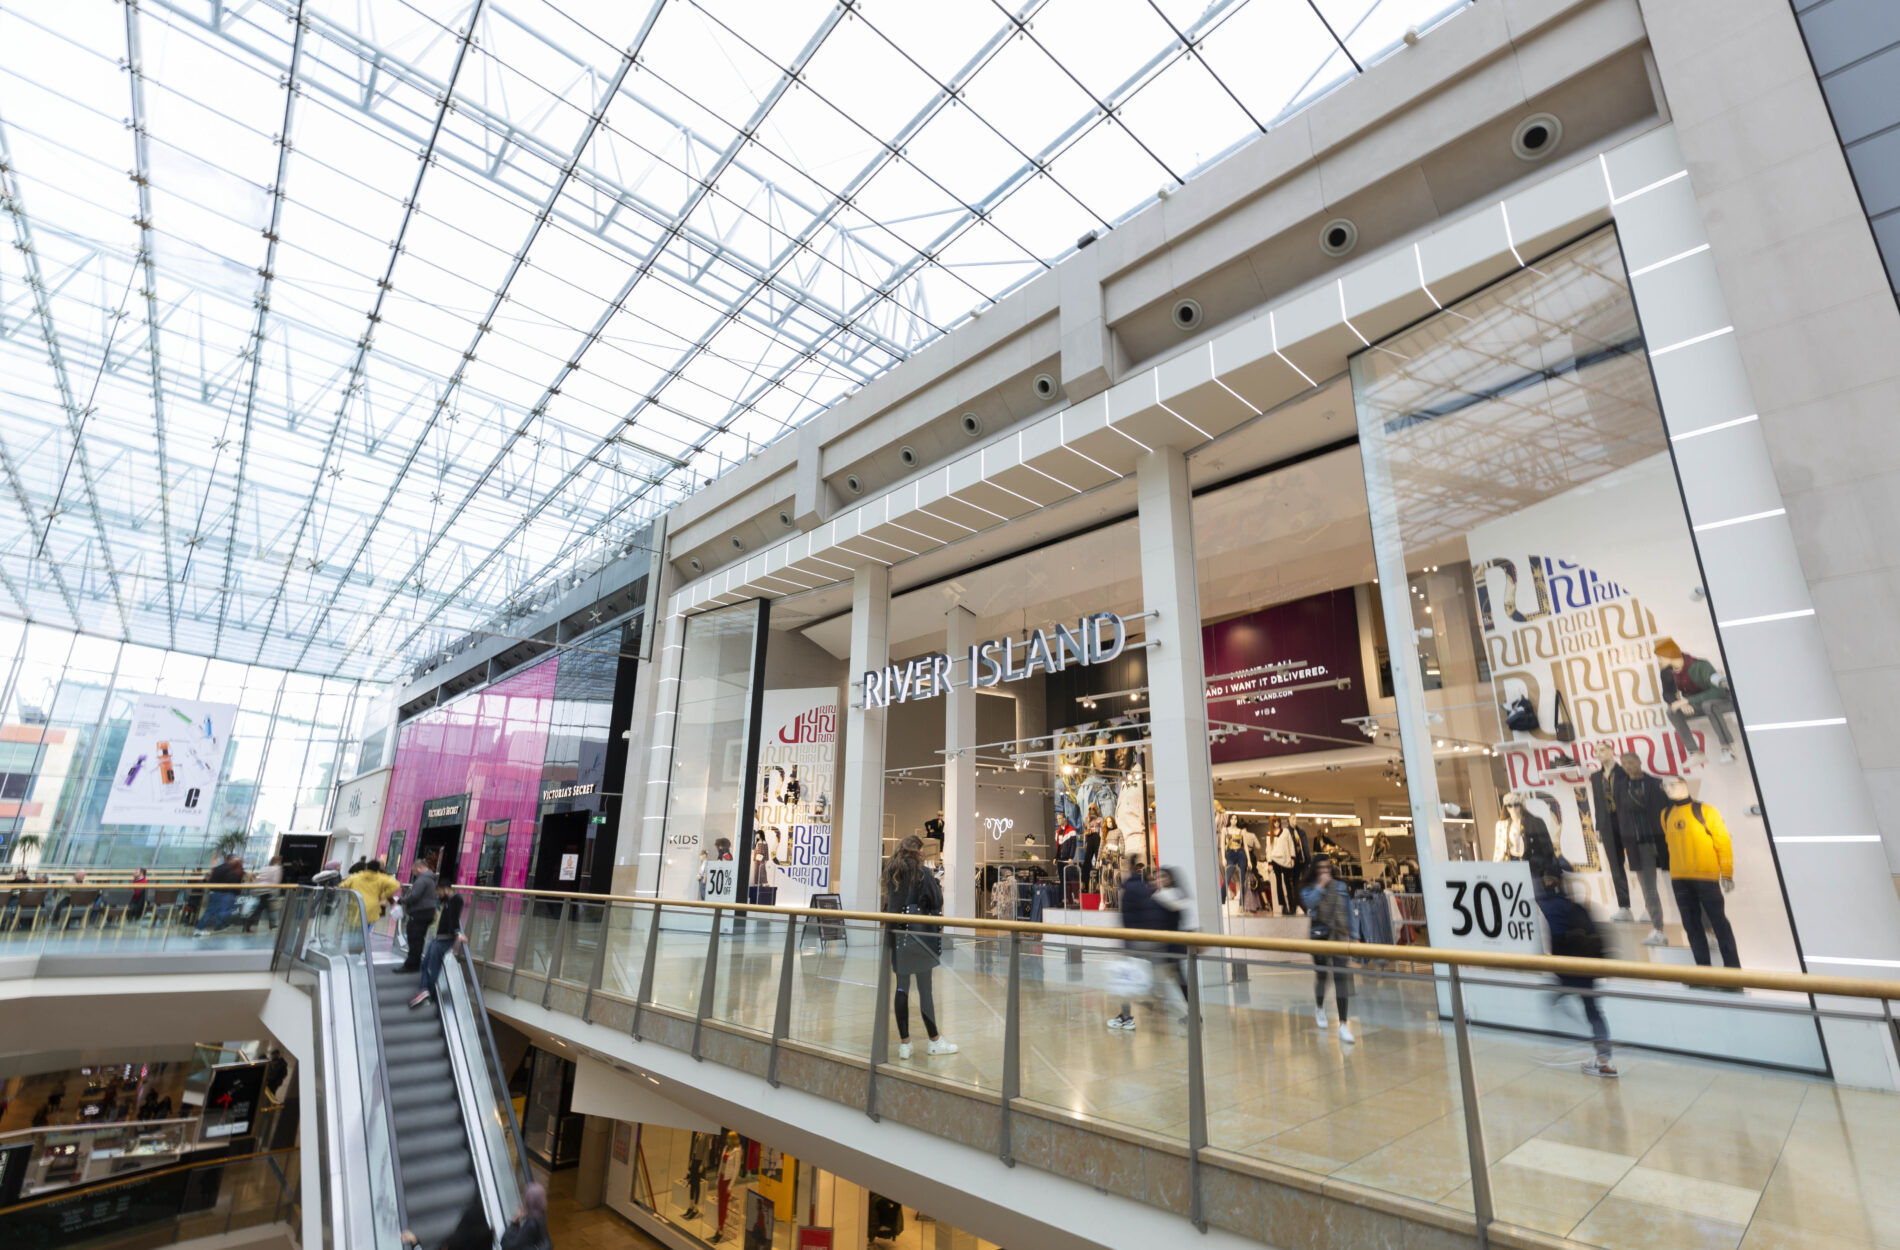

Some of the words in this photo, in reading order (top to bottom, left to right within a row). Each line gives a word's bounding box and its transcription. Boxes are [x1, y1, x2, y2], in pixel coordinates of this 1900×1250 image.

[863, 654, 953, 710] RIVER
[968, 611, 1126, 689] ISLAND
[1206, 687, 1223, 697] AND
[1230, 679, 1257, 693] WANT
[1259, 677, 1269, 687] IT
[1271, 665, 1329, 685] DELIVERED.
[543, 786, 572, 800] VICTORIA'S
[573, 784, 594, 796] SECRET
[669, 834, 698, 845] KIDS
[708, 869, 732, 895] 30%
[1445, 880, 1531, 938] 30%
[1507, 920, 1534, 940] OFF
